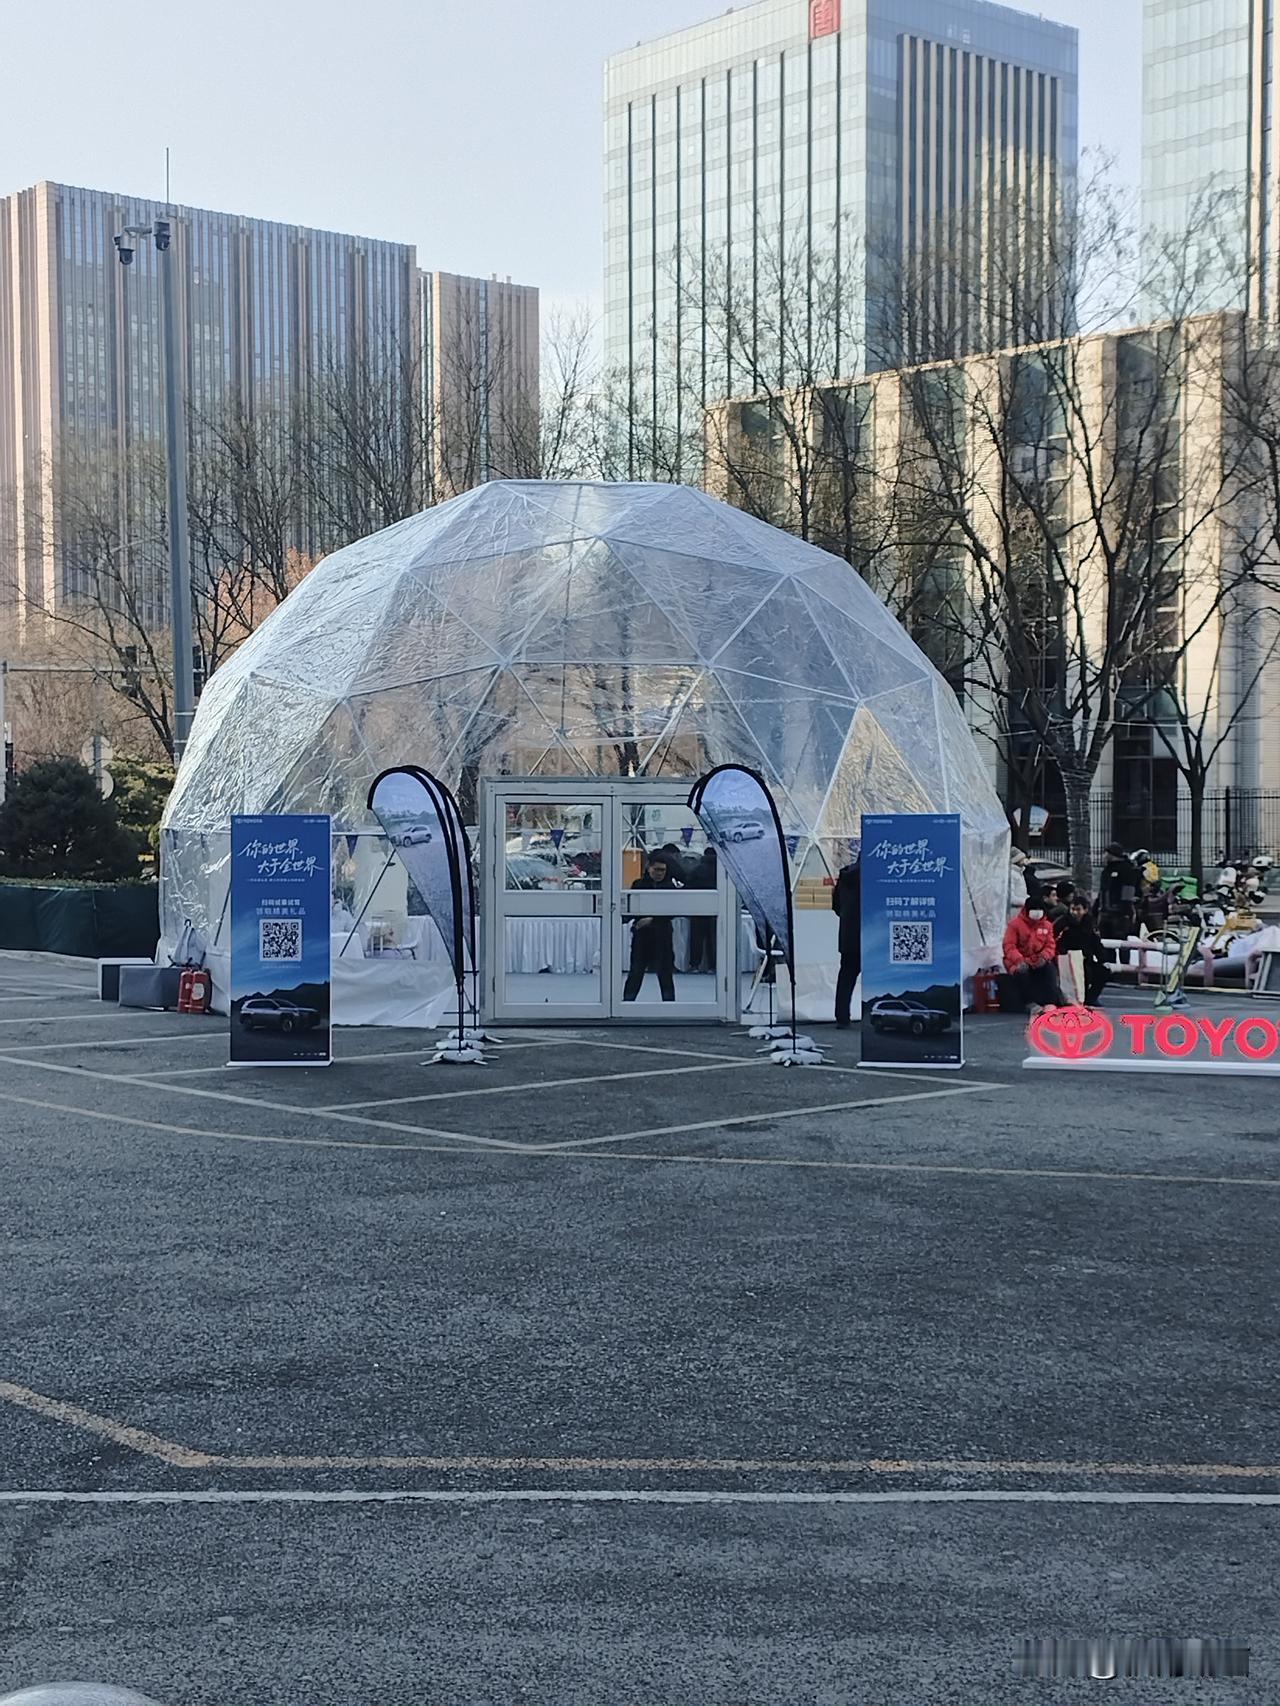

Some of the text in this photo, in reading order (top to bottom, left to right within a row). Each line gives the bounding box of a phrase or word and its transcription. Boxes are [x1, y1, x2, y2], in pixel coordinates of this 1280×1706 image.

[258, 855, 325, 877] 大于全世界
[887, 856, 954, 878] 大于全世界
[1120, 1013, 1280, 1060] TOYO
